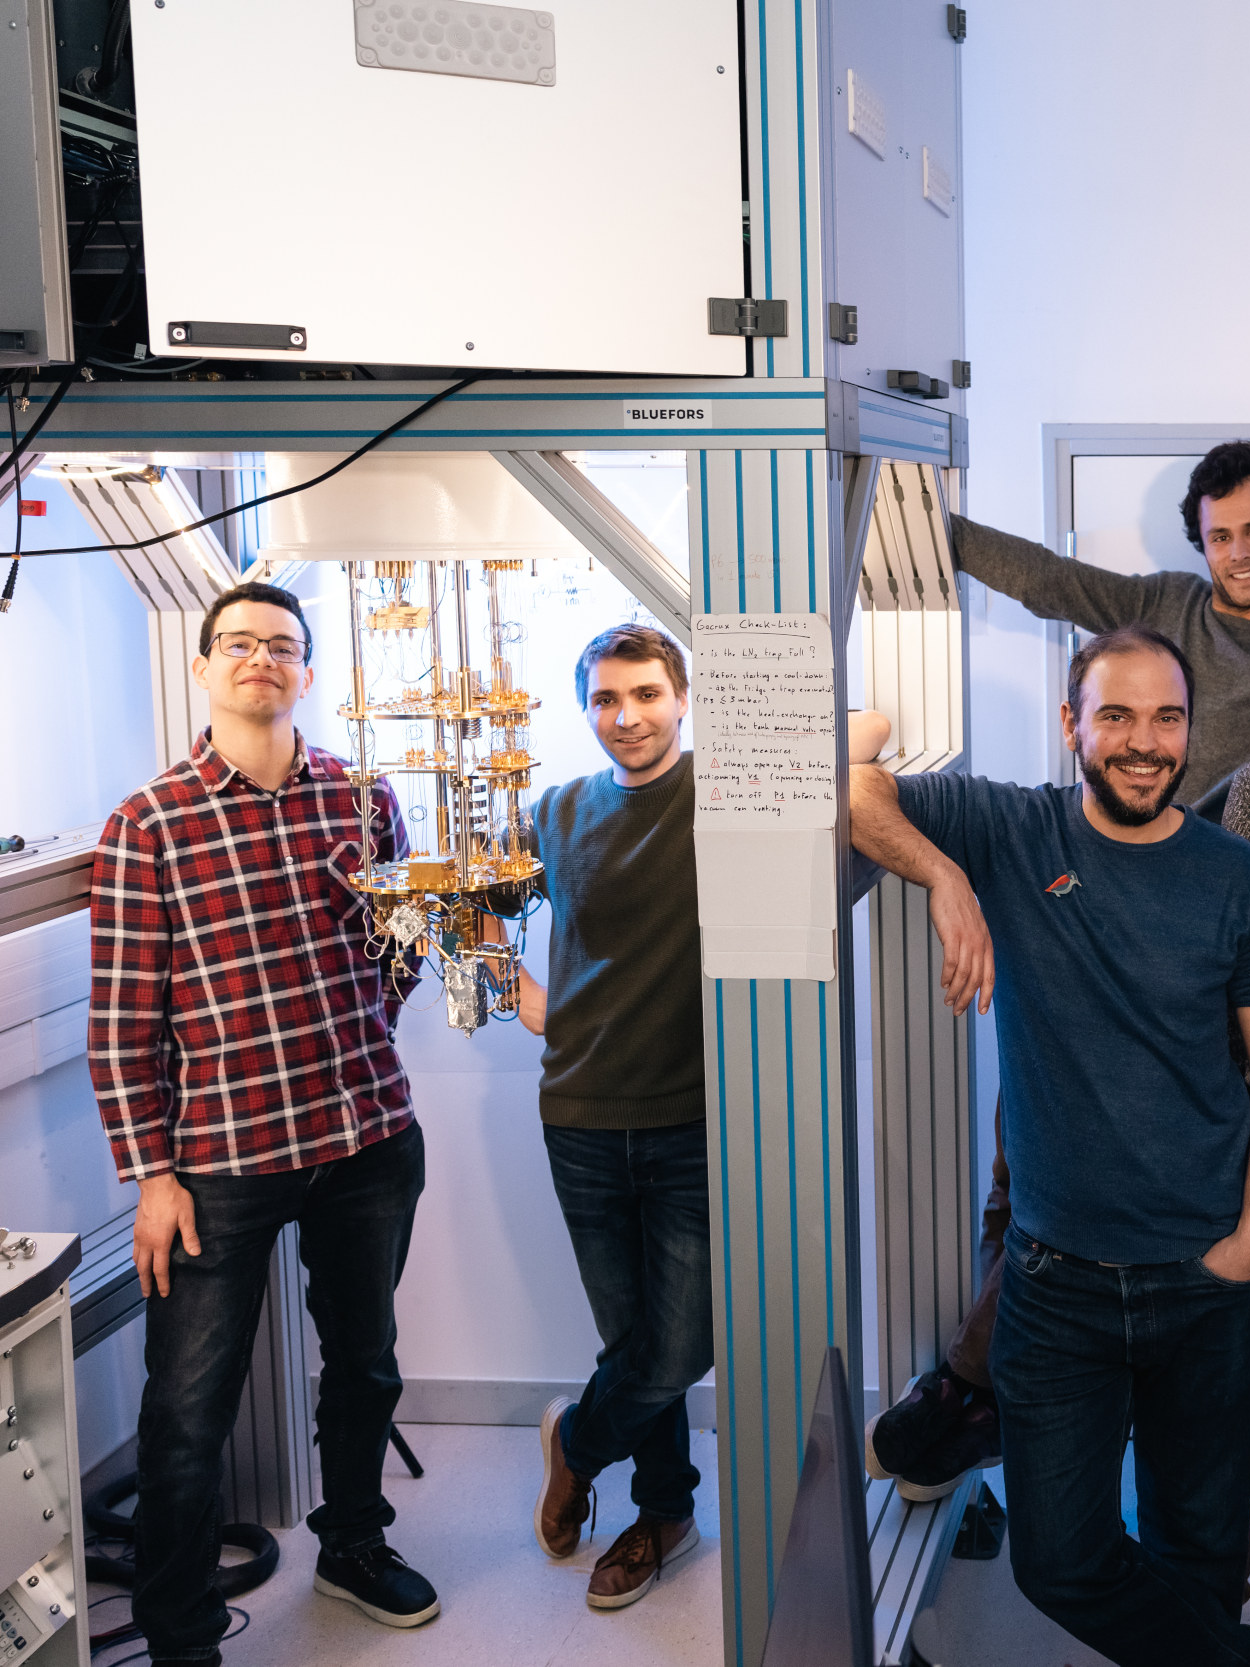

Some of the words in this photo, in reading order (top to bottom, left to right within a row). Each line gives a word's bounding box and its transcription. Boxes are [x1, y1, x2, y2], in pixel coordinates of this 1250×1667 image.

[632, 409, 704, 420] BLUEFORS
[711, 649, 718, 657] is
[724, 648, 736, 657] the
[764, 647, 782, 661] trap
[737, 708, 750, 717] the
[735, 722, 747, 730] the
[723, 759, 749, 771] always
